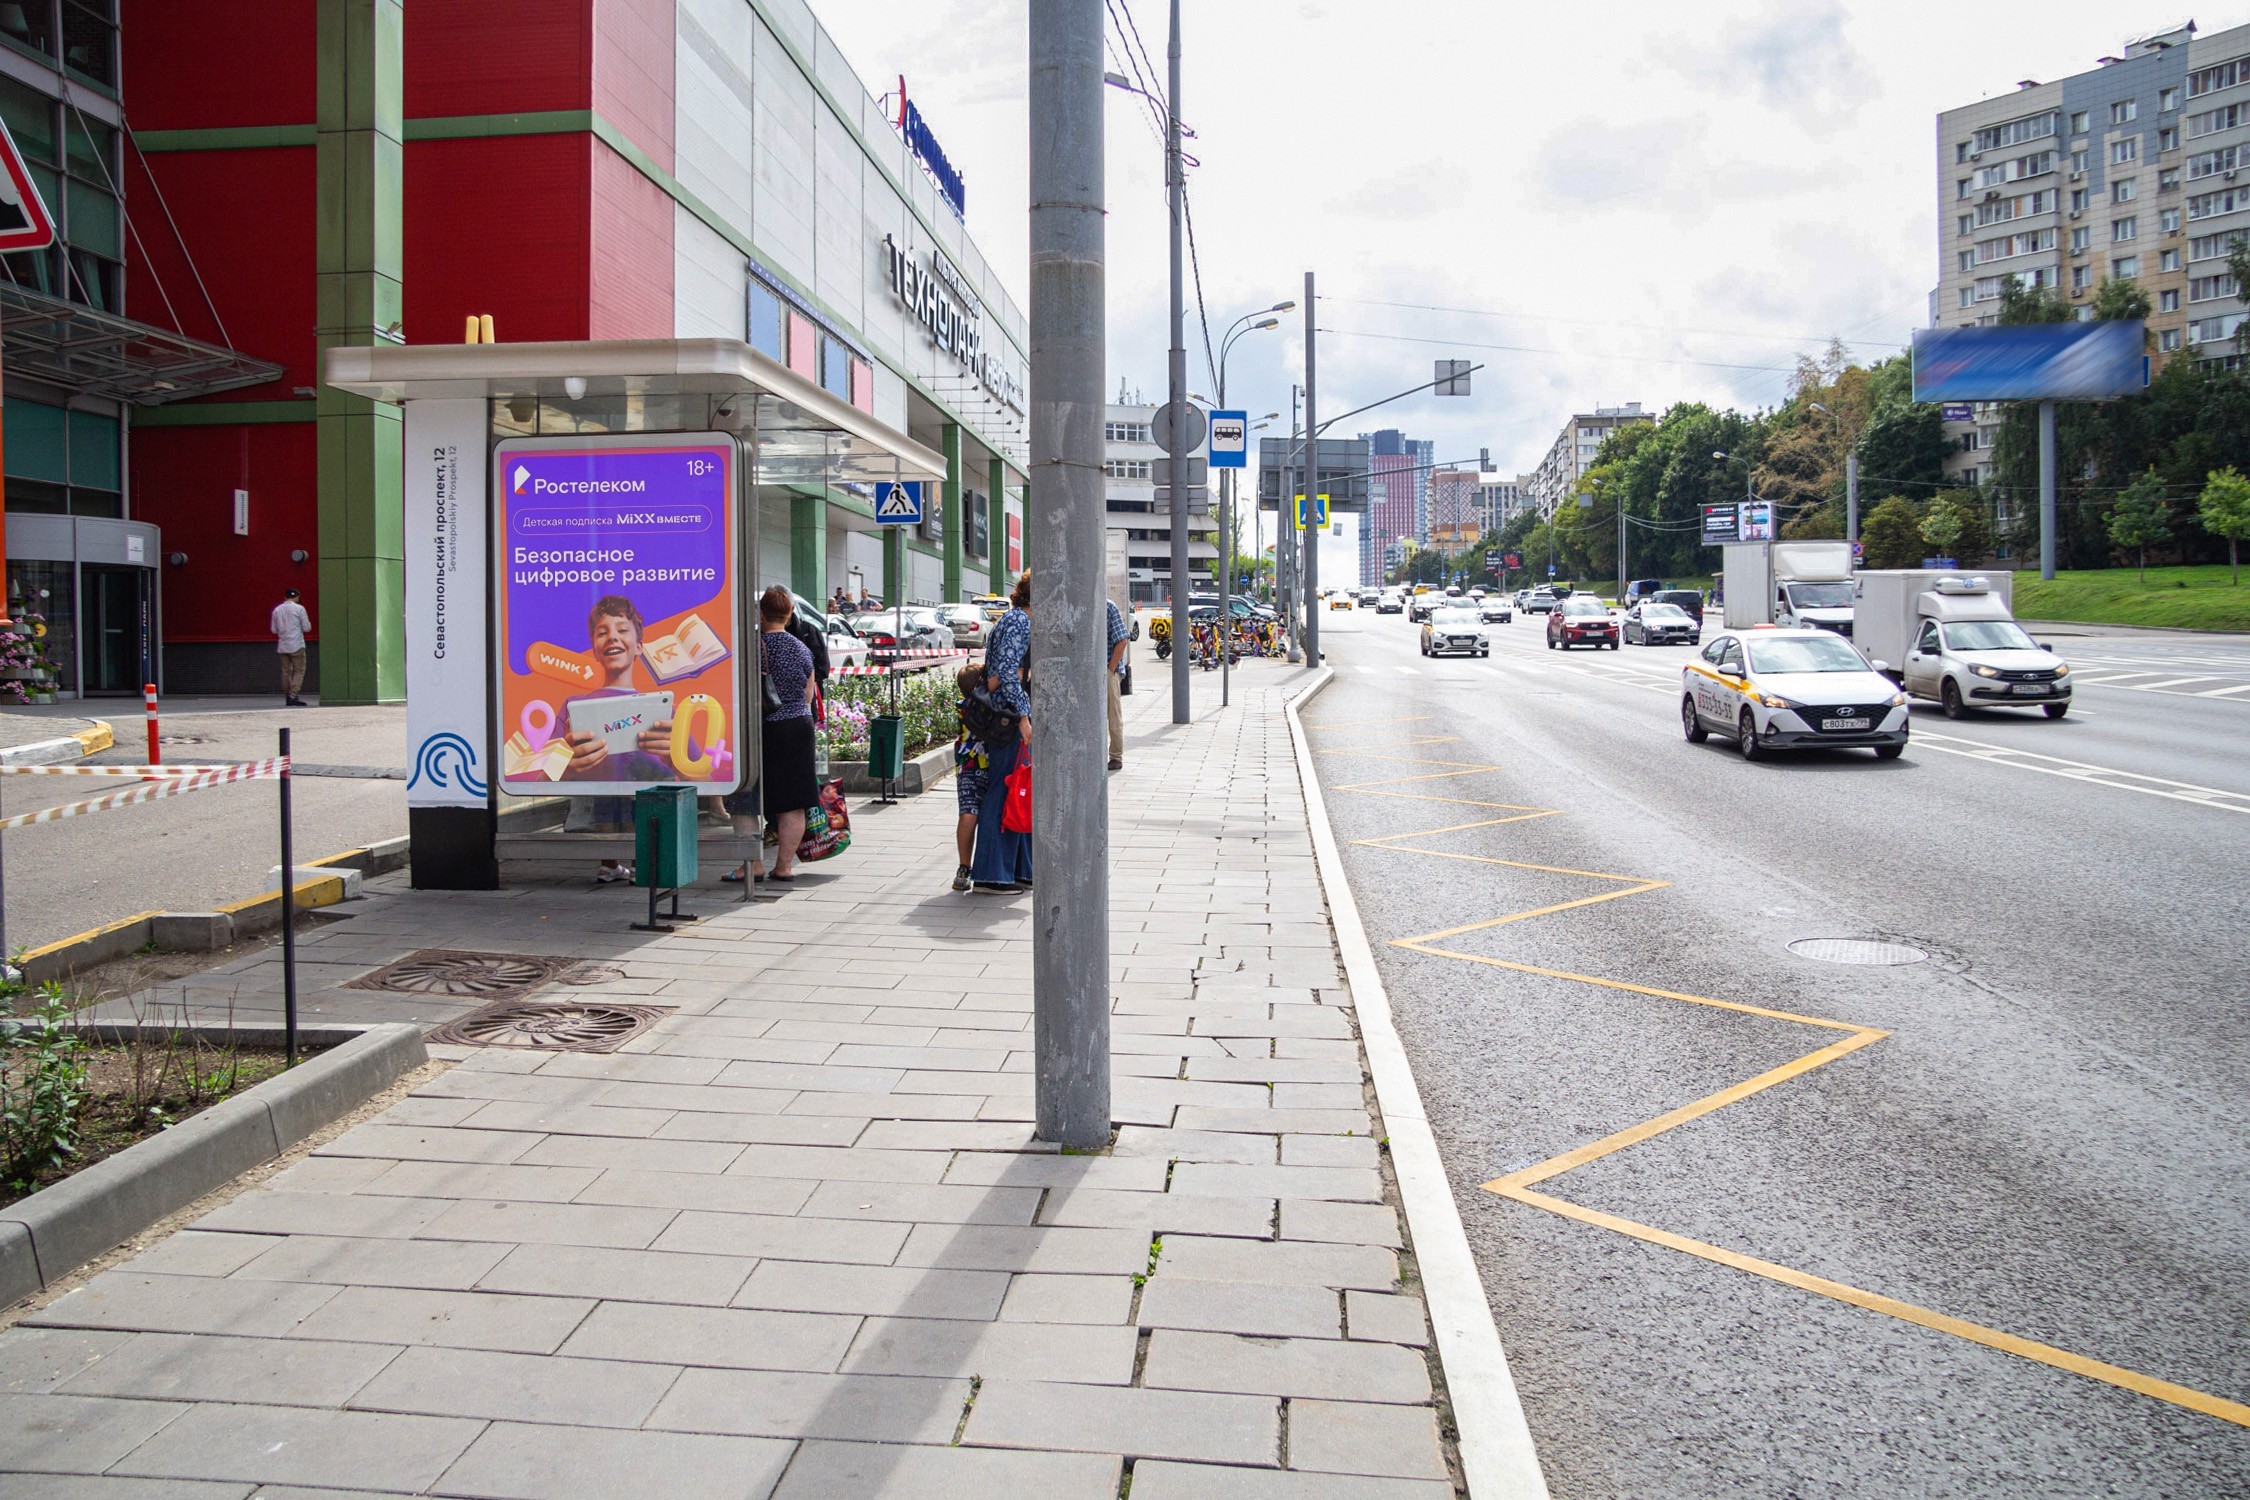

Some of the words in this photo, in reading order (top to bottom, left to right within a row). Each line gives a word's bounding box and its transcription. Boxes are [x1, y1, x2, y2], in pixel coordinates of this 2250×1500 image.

[886, 232, 980, 379] ТЕХНОПАРК
[434, 447, 446, 461] 12
[449, 446, 456, 455] 12
[687, 460, 714, 476] 18+
[535, 478, 645, 494] Ростелеком
[436, 465, 447, 532] проспект,
[523, 517, 563, 527] Детская
[565, 517, 613, 527] подписка
[657, 515, 702, 523] ВМЕСТЕ
[448, 503, 458, 572] Sevastopolskiy
[515, 547, 635, 563] Безопасное
[515, 567, 615, 587] цифровое
[623, 567, 716, 586] развитие
[434, 537, 446, 659] Севастопольский
[540, 653, 580, 675] WINK
